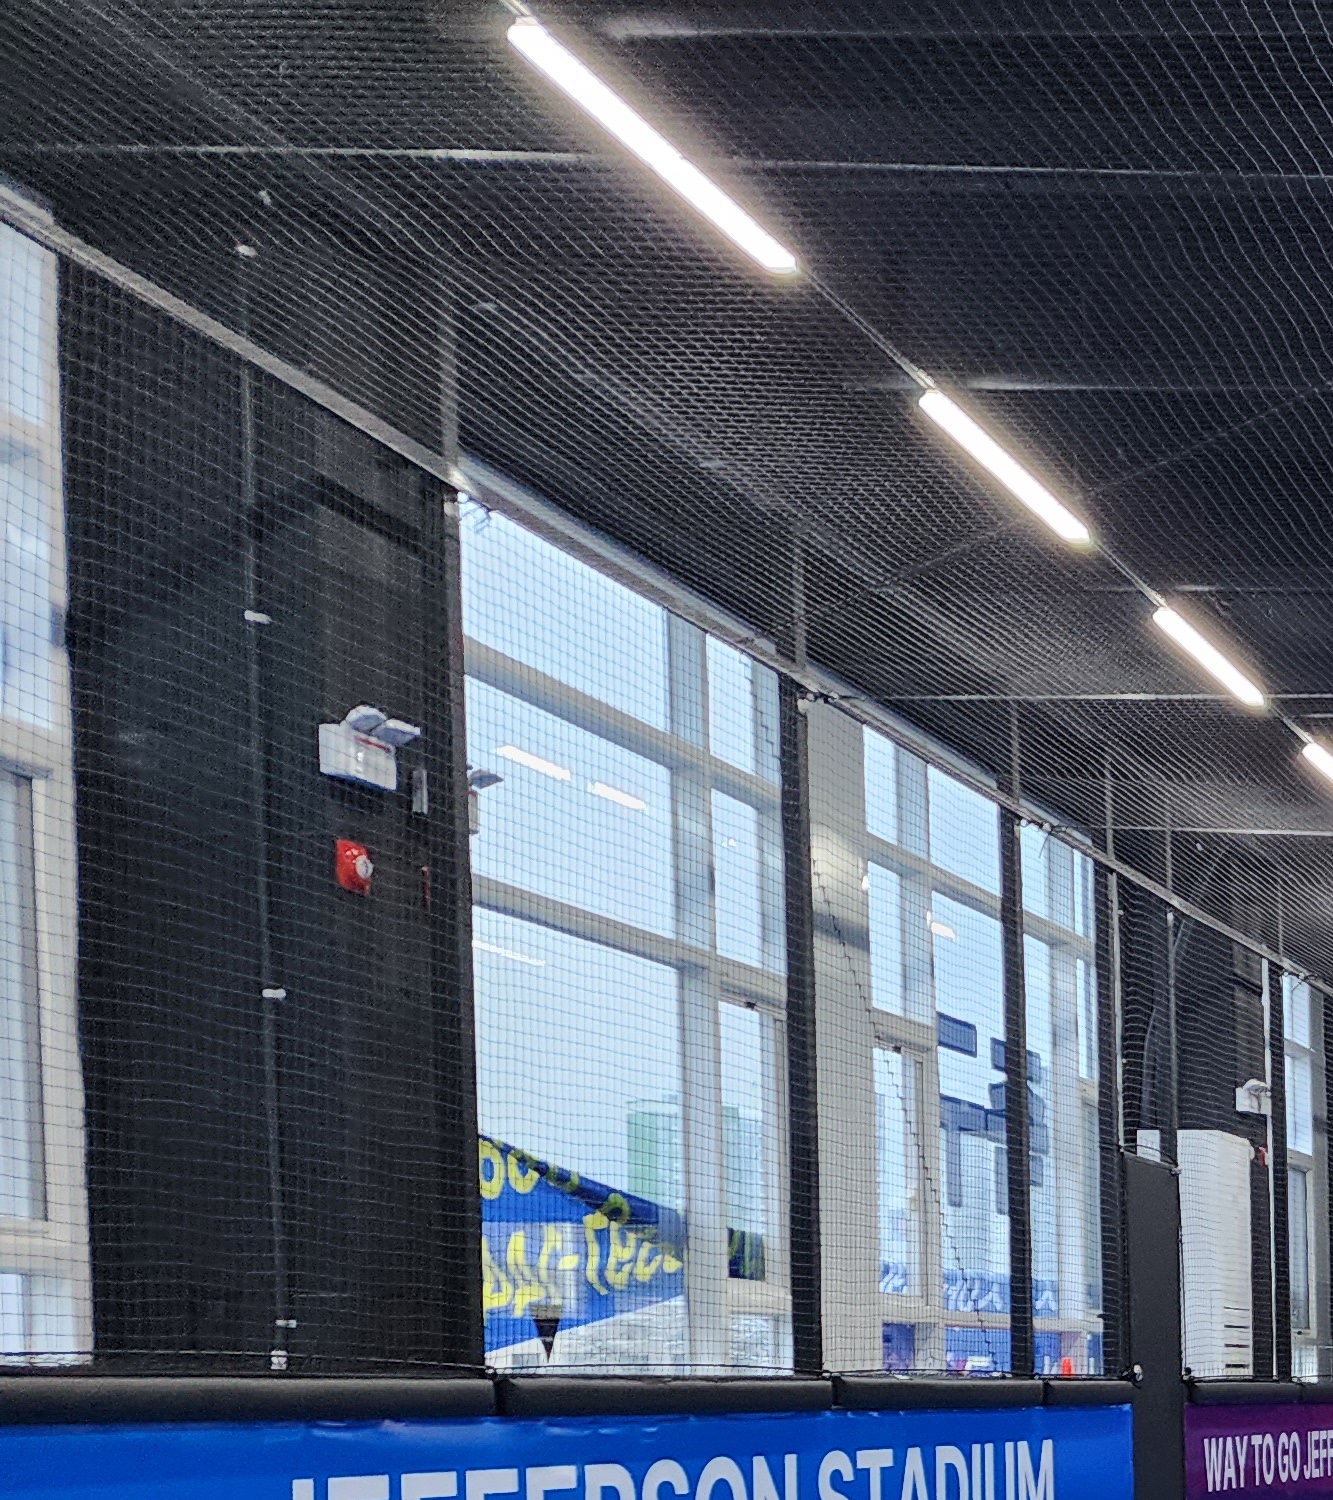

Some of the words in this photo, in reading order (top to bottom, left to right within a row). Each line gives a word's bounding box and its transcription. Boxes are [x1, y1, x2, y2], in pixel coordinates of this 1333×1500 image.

[1203, 1436, 1249, 1493] WAY
[1250, 1433, 1276, 1486] TO
[1277, 1431, 1301, 1483] GO
